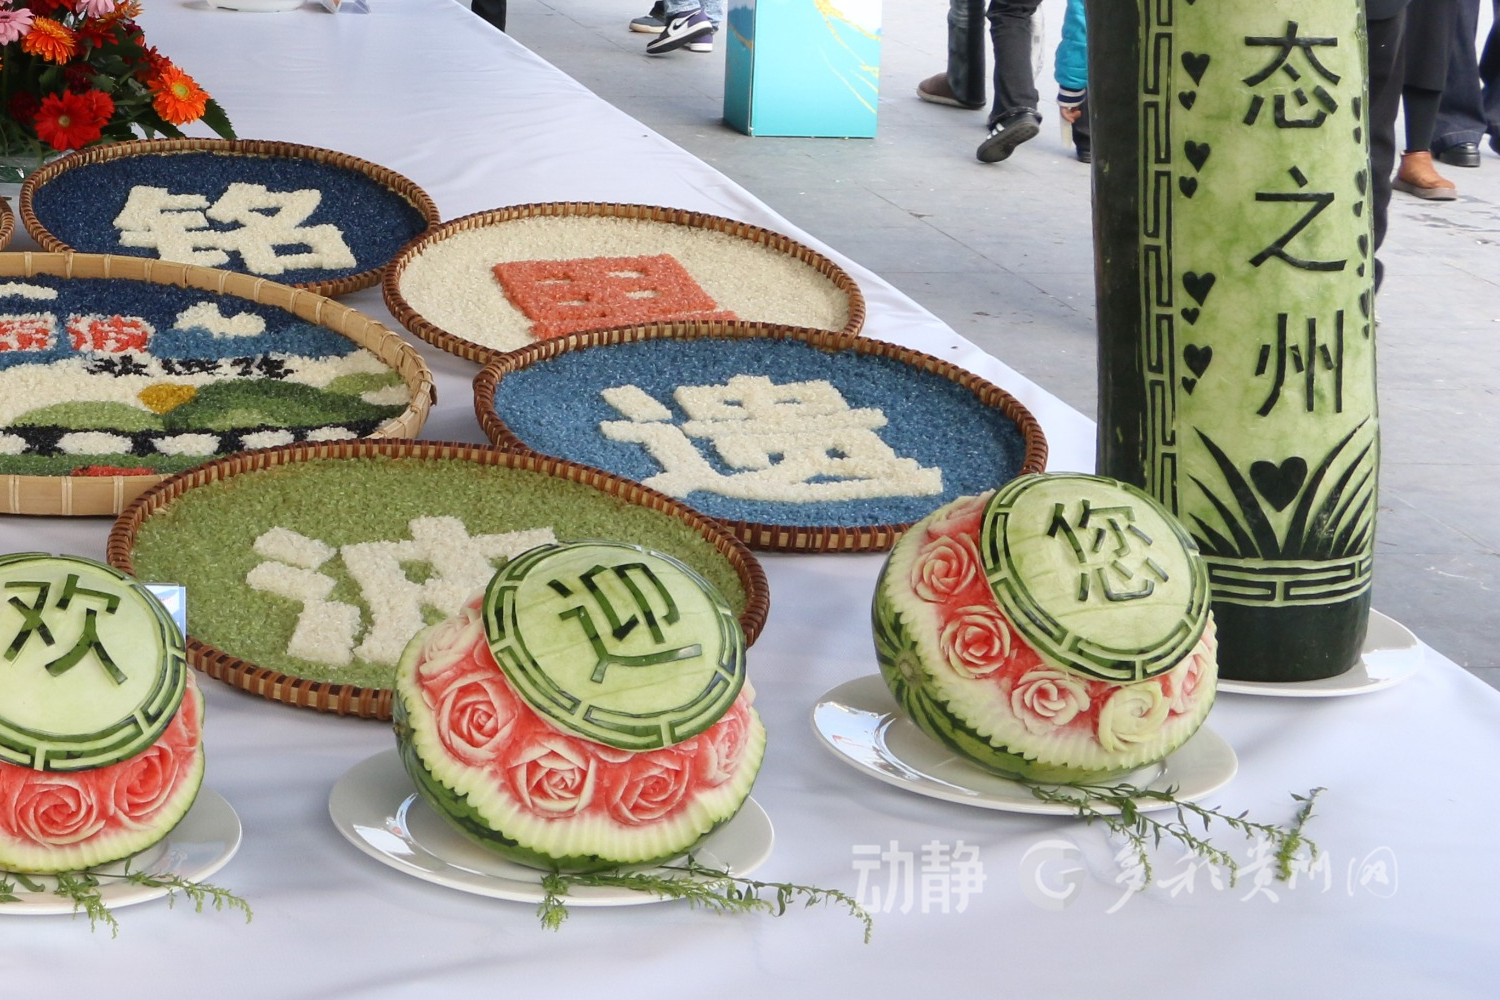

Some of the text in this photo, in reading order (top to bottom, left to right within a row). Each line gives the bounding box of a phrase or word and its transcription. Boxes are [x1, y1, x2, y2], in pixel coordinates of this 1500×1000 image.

[111, 181, 359, 277] 铭
[598, 373, 945, 504] 遗
[1046, 498, 1170, 603] 您
[3, 572, 129, 687] 欢
[549, 561, 702, 685] 迎
